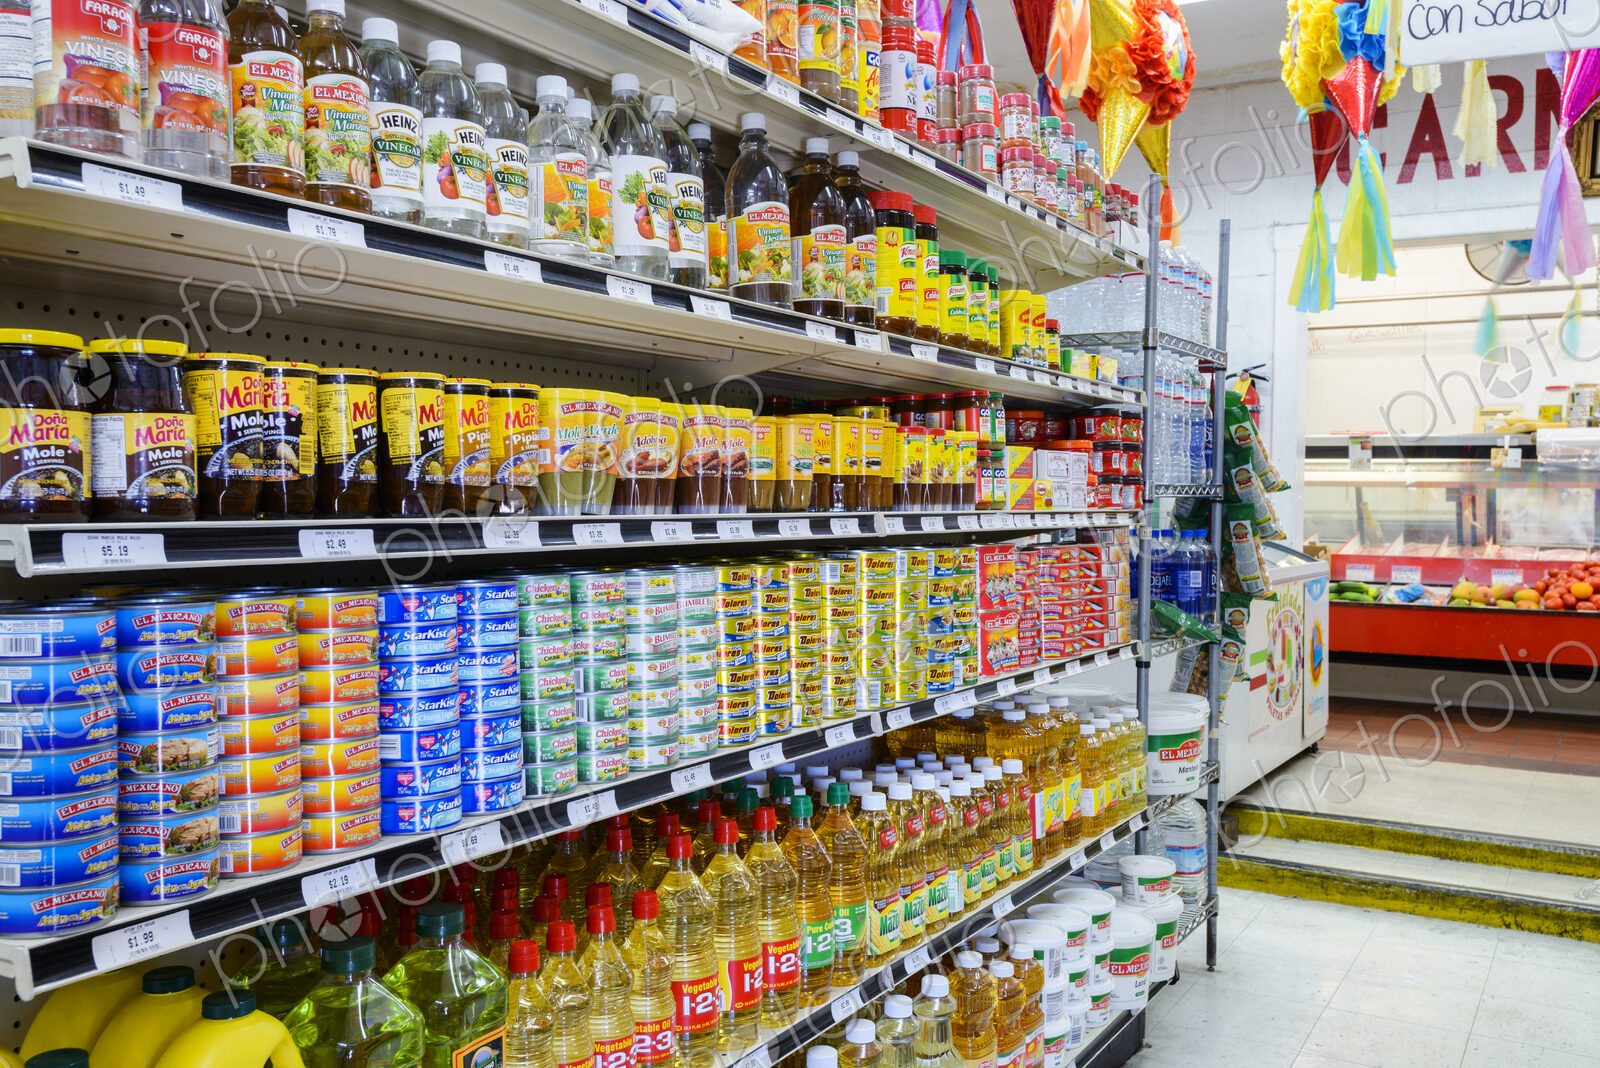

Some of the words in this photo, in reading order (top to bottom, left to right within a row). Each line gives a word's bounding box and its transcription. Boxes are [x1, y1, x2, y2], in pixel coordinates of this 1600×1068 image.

[314, 87, 331, 98] EL
[381, 115, 419, 135] HEINZ
[376, 140, 422, 157] VINEGAR
[118, 182, 146, 198] $1.49
[315, 225, 337, 237] $1.79
[33, 414, 68, 428] Doña
[153, 417, 184, 431] Doña
[10, 425, 70, 446] María
[135, 428, 186, 448] María
[23, 446, 66, 461] Mole
[147, 447, 183, 462] Mole
[325, 539, 346, 550] $2.49
[101, 546, 129, 558] $5.19
[230, 608, 243, 619] EL
[243, 604, 288, 615] MEXICANO
[135, 617, 150, 627] EL
[150, 612, 201, 625] MEXICANO
[402, 629, 448, 641] StarKist
[142, 660, 156, 670] EL
[156, 655, 206, 668] MEXICANO
[458, 655, 503, 666] StarKist
[411, 662, 453, 676] StarKist
[483, 751, 520, 765] StarKist
[1161, 750, 1175, 761] EL
[149, 871, 161, 881] EL
[162, 860, 210, 878] MEXICANO
[328, 875, 349, 889] $2.19
[34, 901, 50, 912] EL
[51, 889, 106, 907] MEXICANO
[806, 925, 823, 935] Pure
[127, 931, 154, 949] $1.99
[1111, 964, 1122, 974] EL
[662, 1019, 671, 1030] Oil
